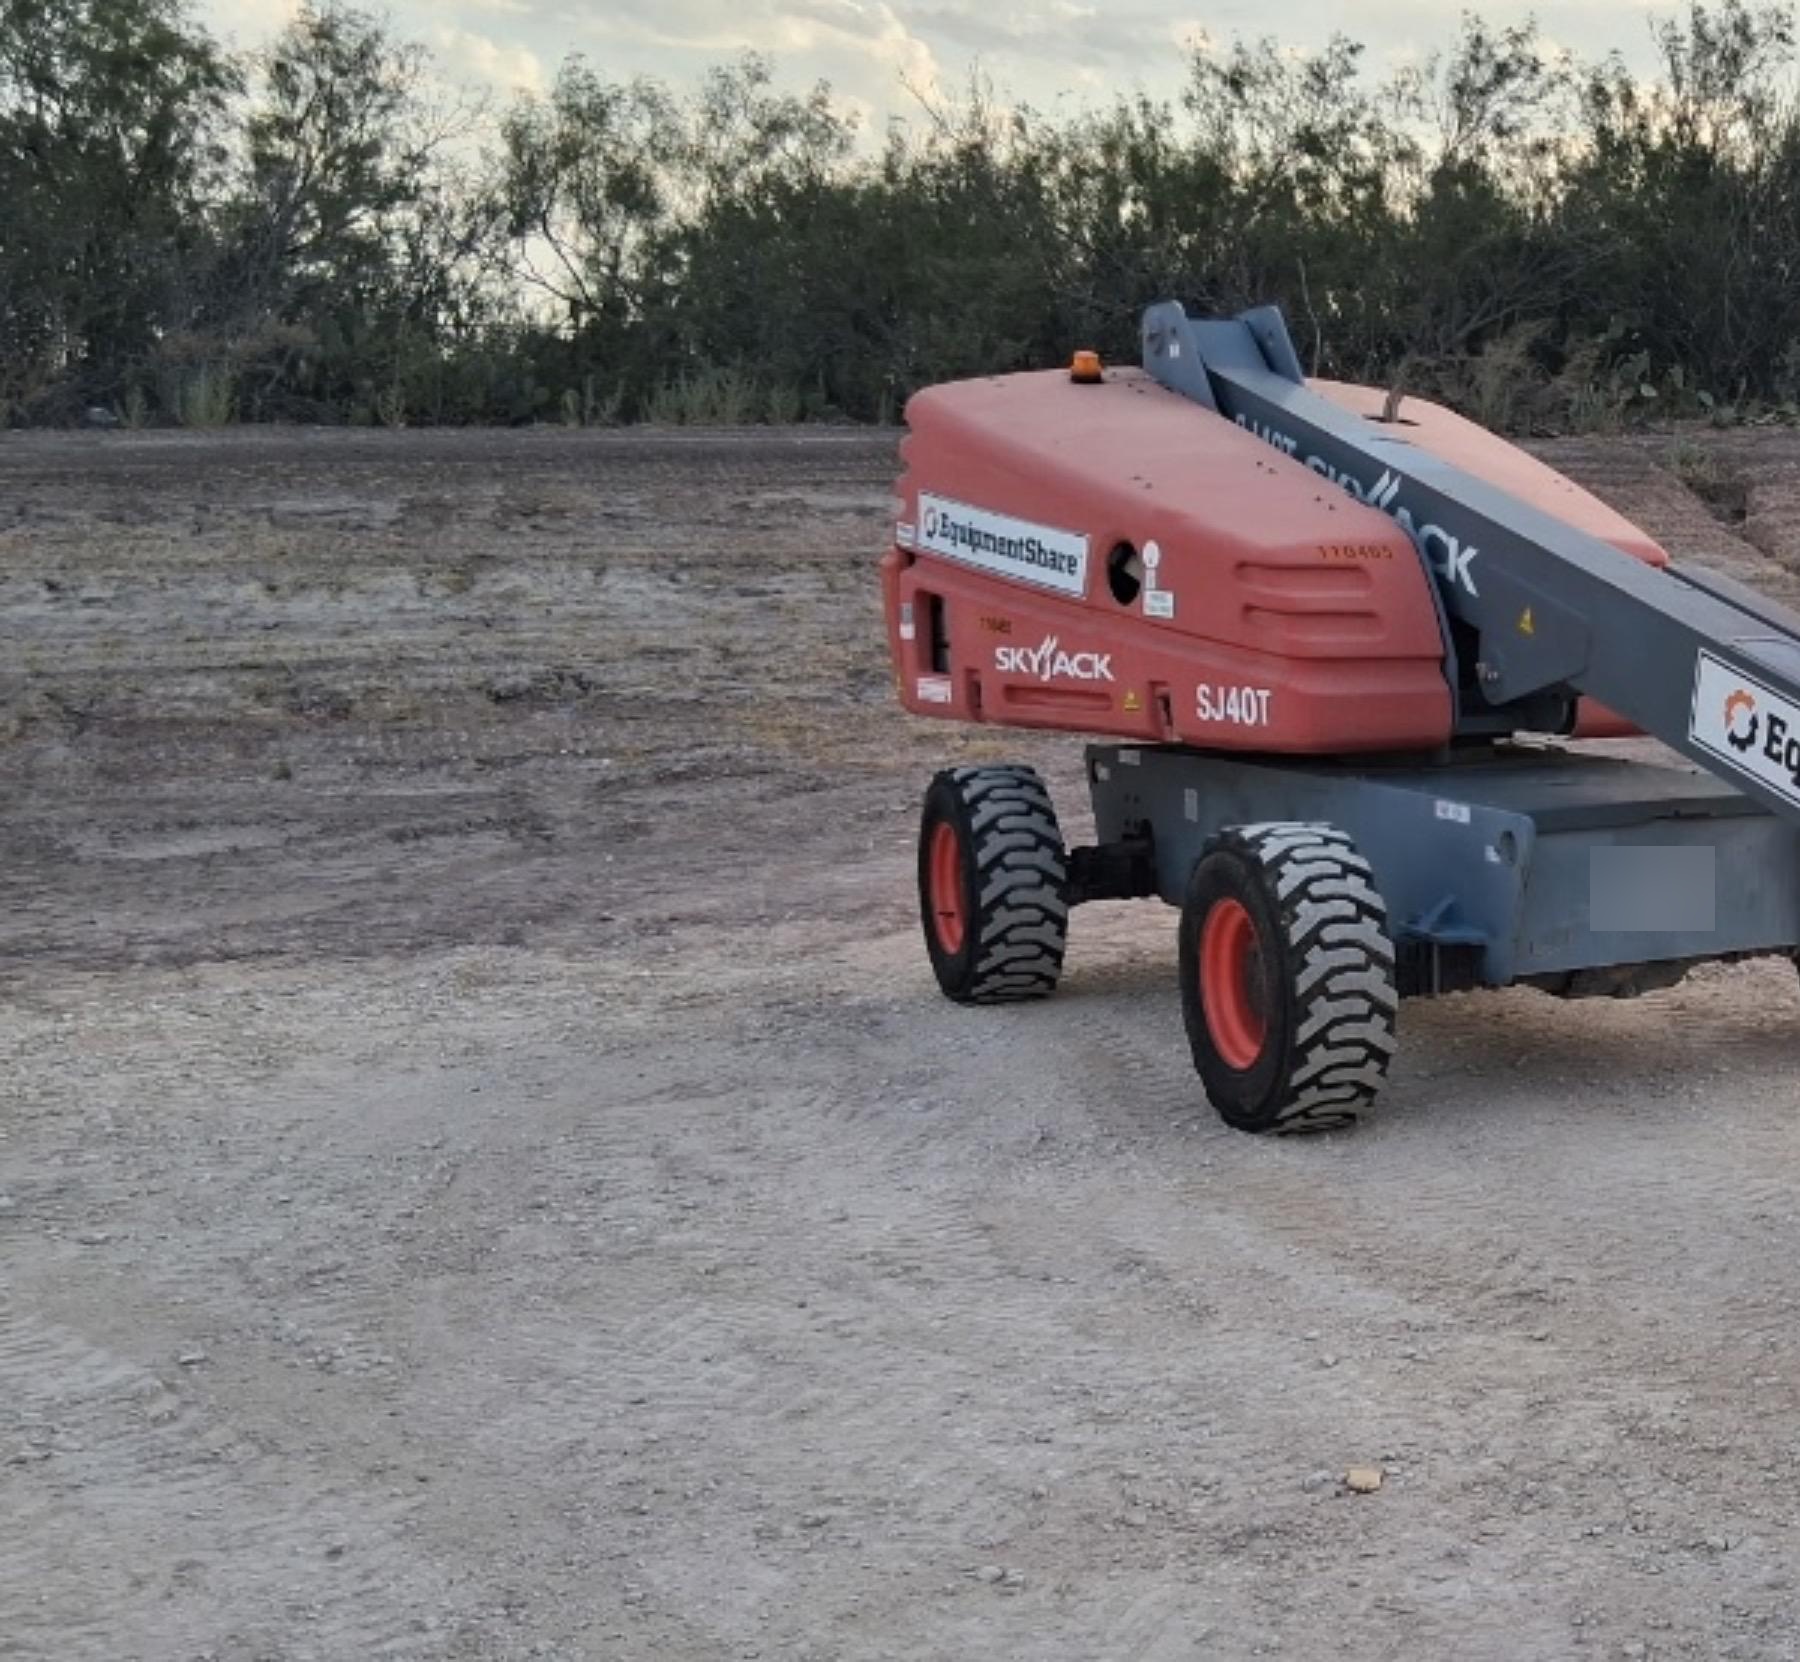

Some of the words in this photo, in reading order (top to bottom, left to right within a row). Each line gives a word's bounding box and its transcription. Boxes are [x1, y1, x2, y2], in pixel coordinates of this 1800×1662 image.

[938, 511, 1078, 575] EquipmentShare
[995, 634, 1115, 681] SKYJACK
[1196, 683, 1272, 726] SJ40T
